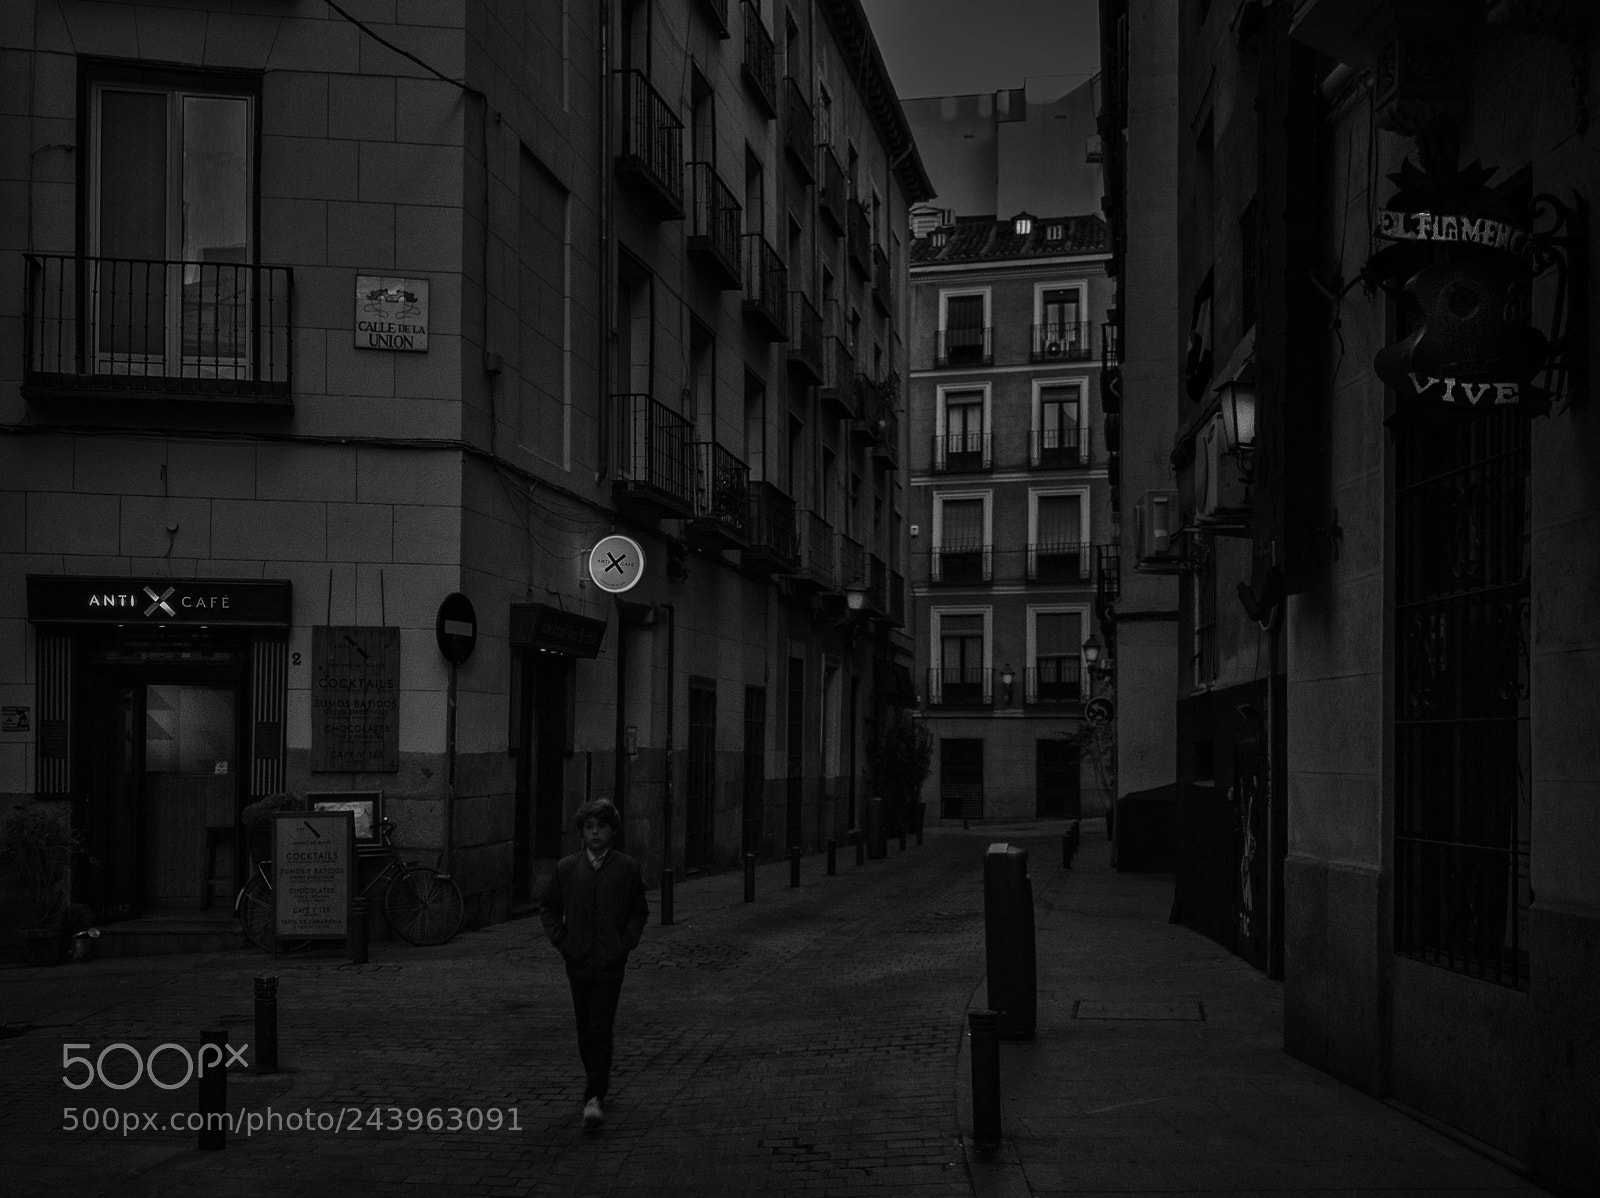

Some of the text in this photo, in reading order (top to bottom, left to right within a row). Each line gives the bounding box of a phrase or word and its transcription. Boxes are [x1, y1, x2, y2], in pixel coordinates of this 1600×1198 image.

[358, 320, 426, 335] CALLE DE LA
[369, 333, 414, 349] UNION
[1407, 373, 1520, 406] VIVE
[88, 593, 136, 608] ANTI
[181, 593, 231, 609] CAFÉ
[292, 652, 302, 666] 2
[318, 678, 394, 689] COCKTAILS
[314, 699, 397, 708] ZUMOS BATIDOS
[325, 724, 391, 733] CHOCOLATES
[286, 851, 338, 860] COCKTAILS
